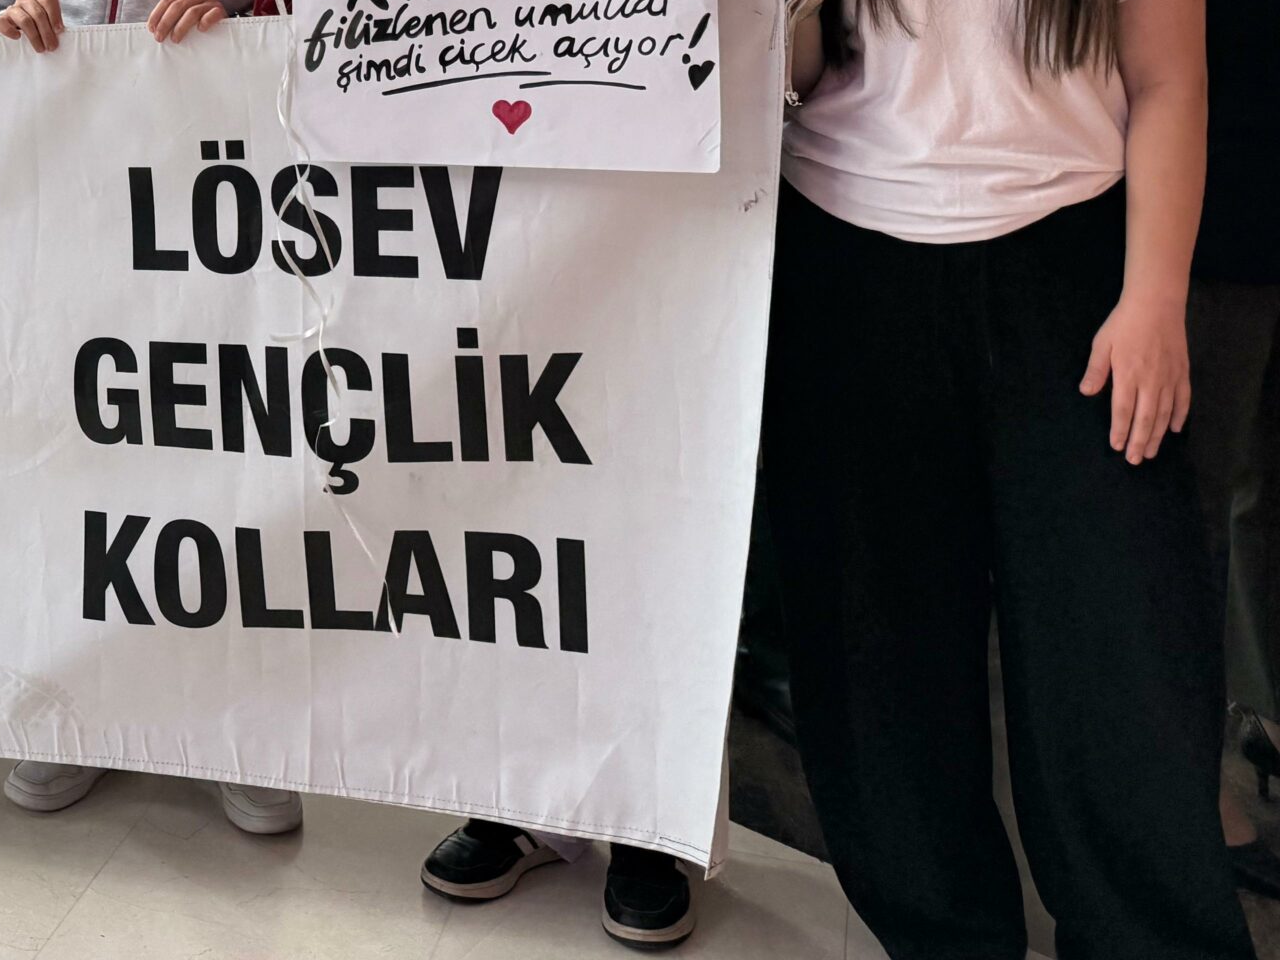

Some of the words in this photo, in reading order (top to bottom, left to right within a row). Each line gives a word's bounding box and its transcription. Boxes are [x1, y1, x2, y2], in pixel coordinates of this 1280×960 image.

[304, 3, 498, 72] filizlenen
[336, 43, 427, 93] şimdi
[438, 33, 537, 73] çiçek
[552, 12, 711, 74] açıyor!
[128, 140, 504, 280] LÖSEV
[73, 327, 593, 495] GENÇLİK
[82, 509, 589, 654] KOLLARI
